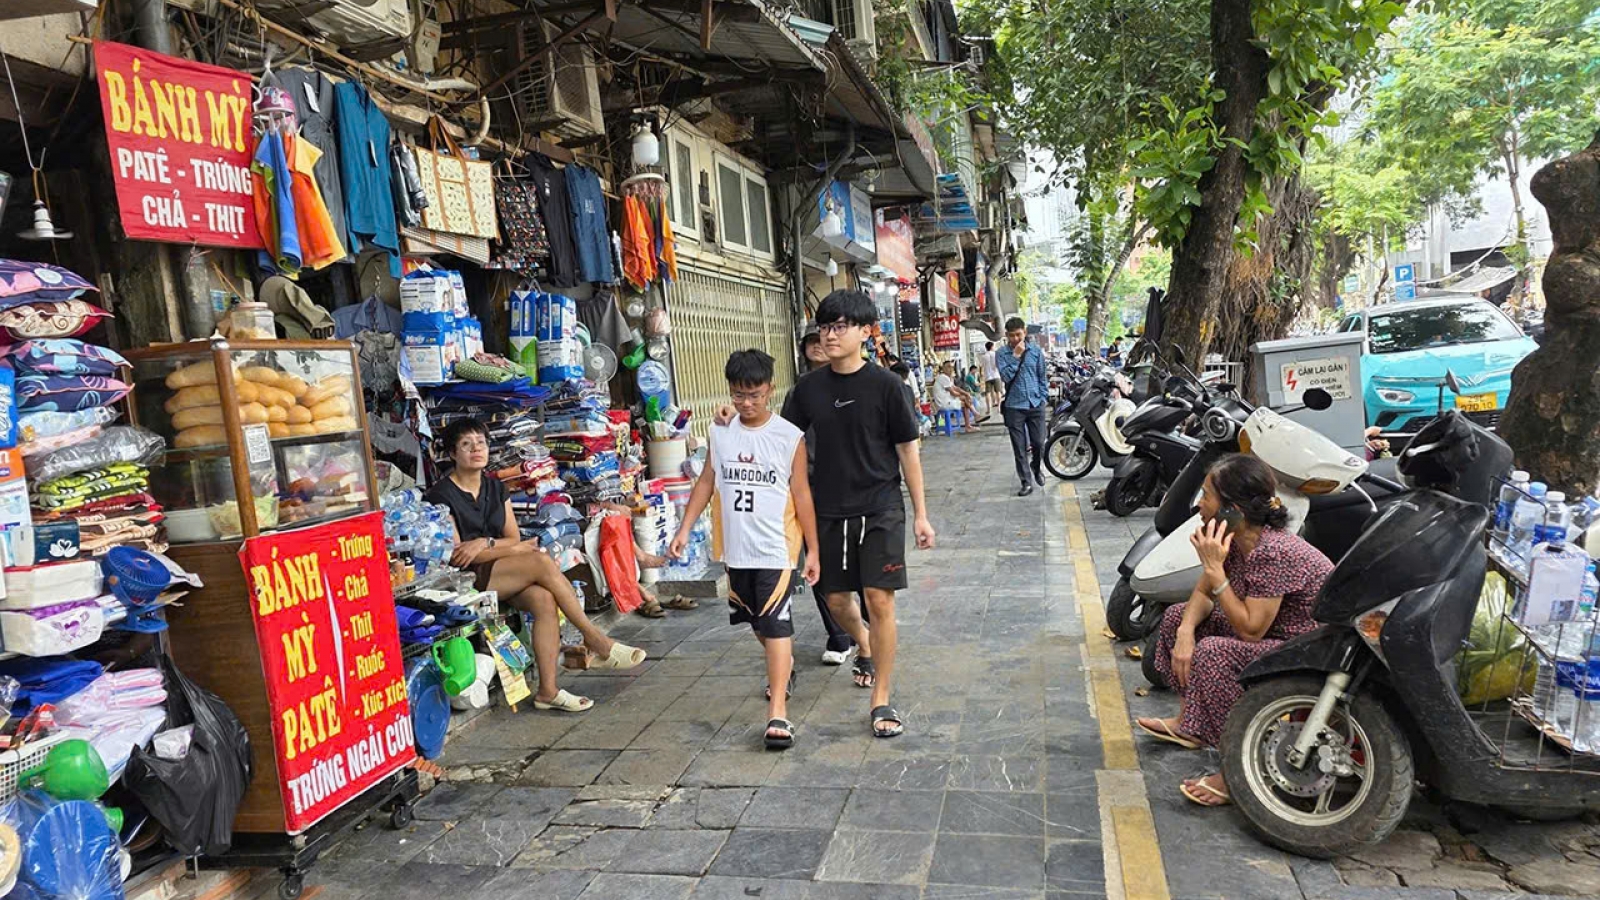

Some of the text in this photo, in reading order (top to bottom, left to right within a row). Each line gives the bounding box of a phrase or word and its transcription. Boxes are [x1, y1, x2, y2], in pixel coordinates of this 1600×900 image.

[104, 58, 203, 144] BÁNH
[117, 147, 171, 184] PATÊ
[190, 157, 253, 196] TRỨNG
[142, 189, 188, 229] CHẢ
[205, 203, 246, 239] THỊT
[1399, 268, 1410, 279] P
[734, 490, 754, 512] 23
[338, 533, 373, 562] Trứng
[250, 546, 324, 617] BÁNH
[344, 568, 369, 601] Chả
[350, 611, 374, 641] Thịt
[355, 644, 386, 681] Ruốc
[282, 674, 341, 760] PATÊ
[360, 690, 385, 720] Xúc
[287, 712, 414, 815] TRỨNG NGẢI CỨU
